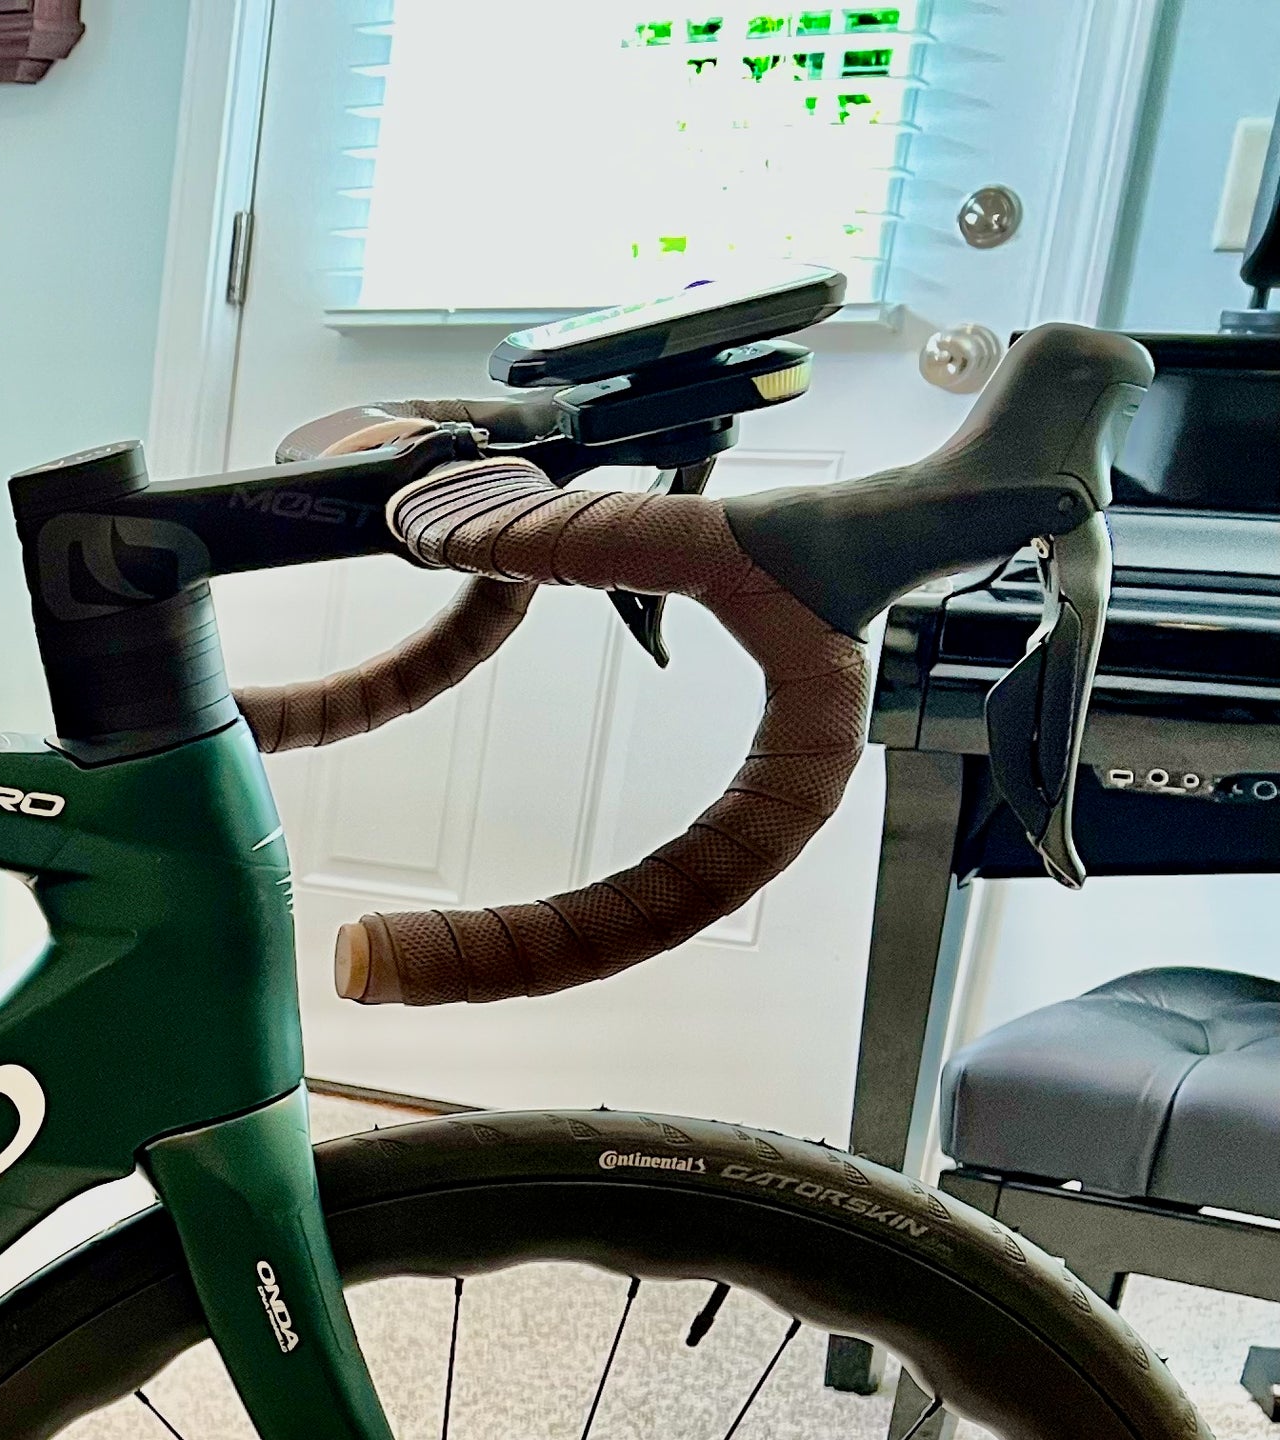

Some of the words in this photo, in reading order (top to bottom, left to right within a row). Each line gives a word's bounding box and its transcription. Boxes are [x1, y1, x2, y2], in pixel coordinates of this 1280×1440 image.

[599, 1150, 694, 1172] Continental
[720, 1164, 929, 1238] GATORSKIN
[256, 1260, 299, 1352] ONDA
